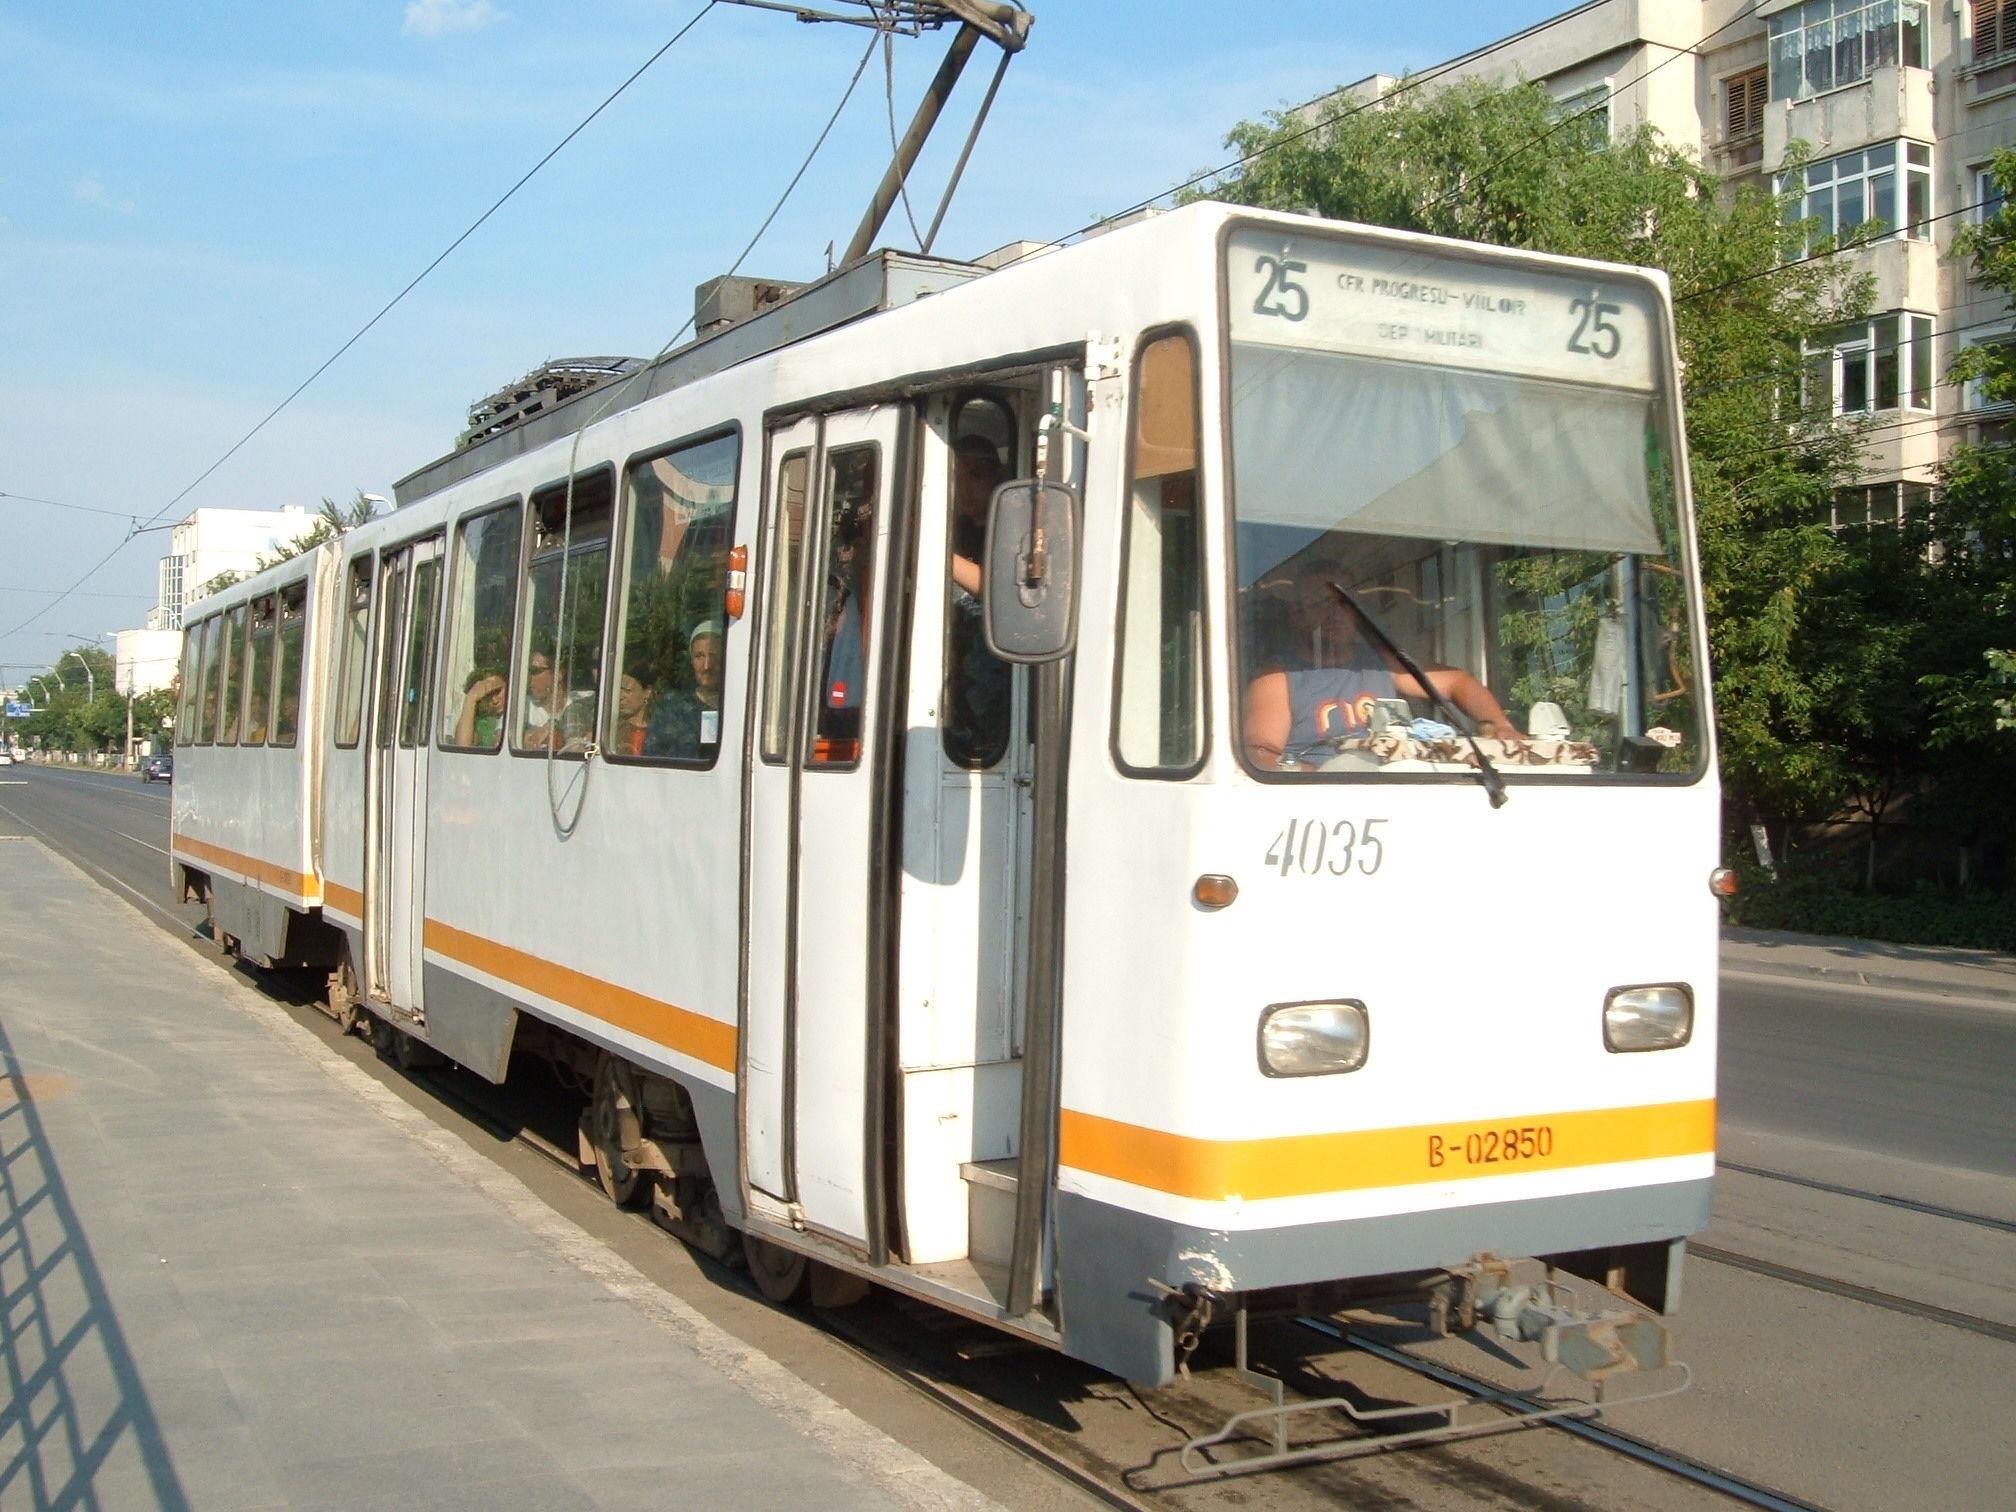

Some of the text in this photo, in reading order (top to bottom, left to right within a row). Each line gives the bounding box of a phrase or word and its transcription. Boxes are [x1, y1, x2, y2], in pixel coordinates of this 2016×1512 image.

[1253, 256, 1309, 322] 25
[1337, 273, 1364, 293] CFR
[1567, 298, 1621, 360] 25
[1264, 818, 1390, 877] 4035
[1428, 1126, 1553, 1168] B-02850
